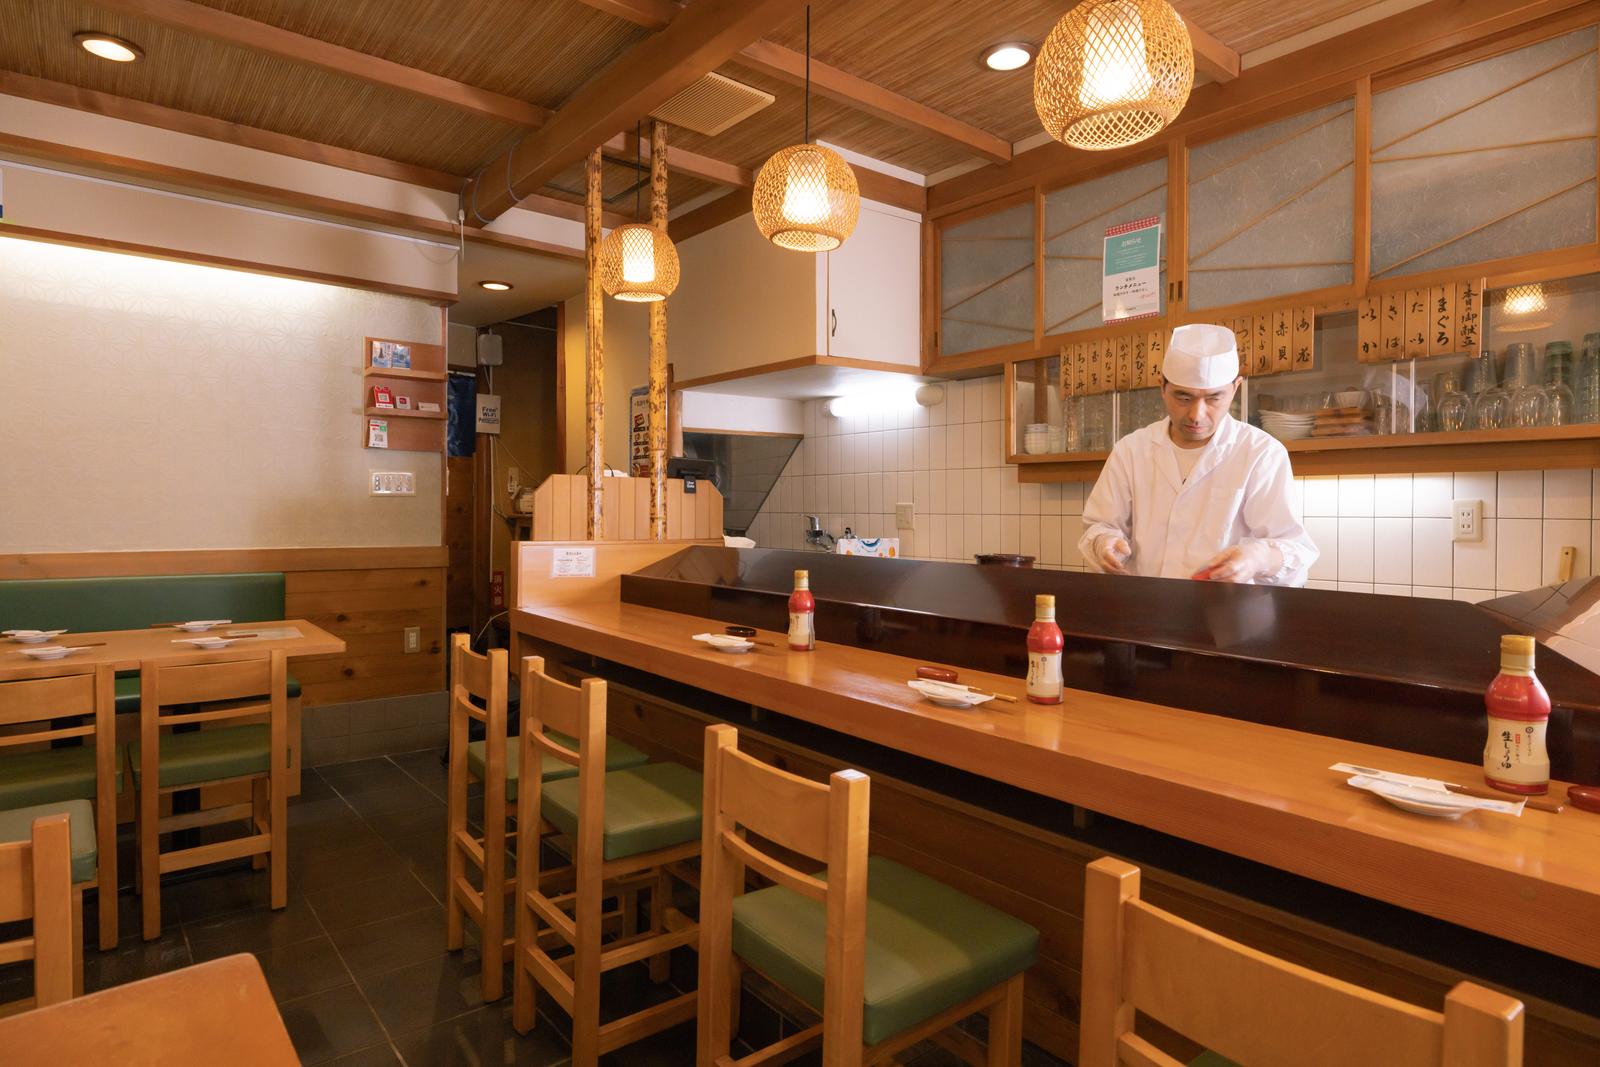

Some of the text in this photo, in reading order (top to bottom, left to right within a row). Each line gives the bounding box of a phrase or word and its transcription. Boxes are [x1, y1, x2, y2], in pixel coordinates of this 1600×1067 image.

[1115, 281, 1147, 291] ランチメニュー
[1361, 308, 1377, 354] いか
[1409, 301, 1424, 345] たい
[1437, 296, 1449, 346] まぐろ
